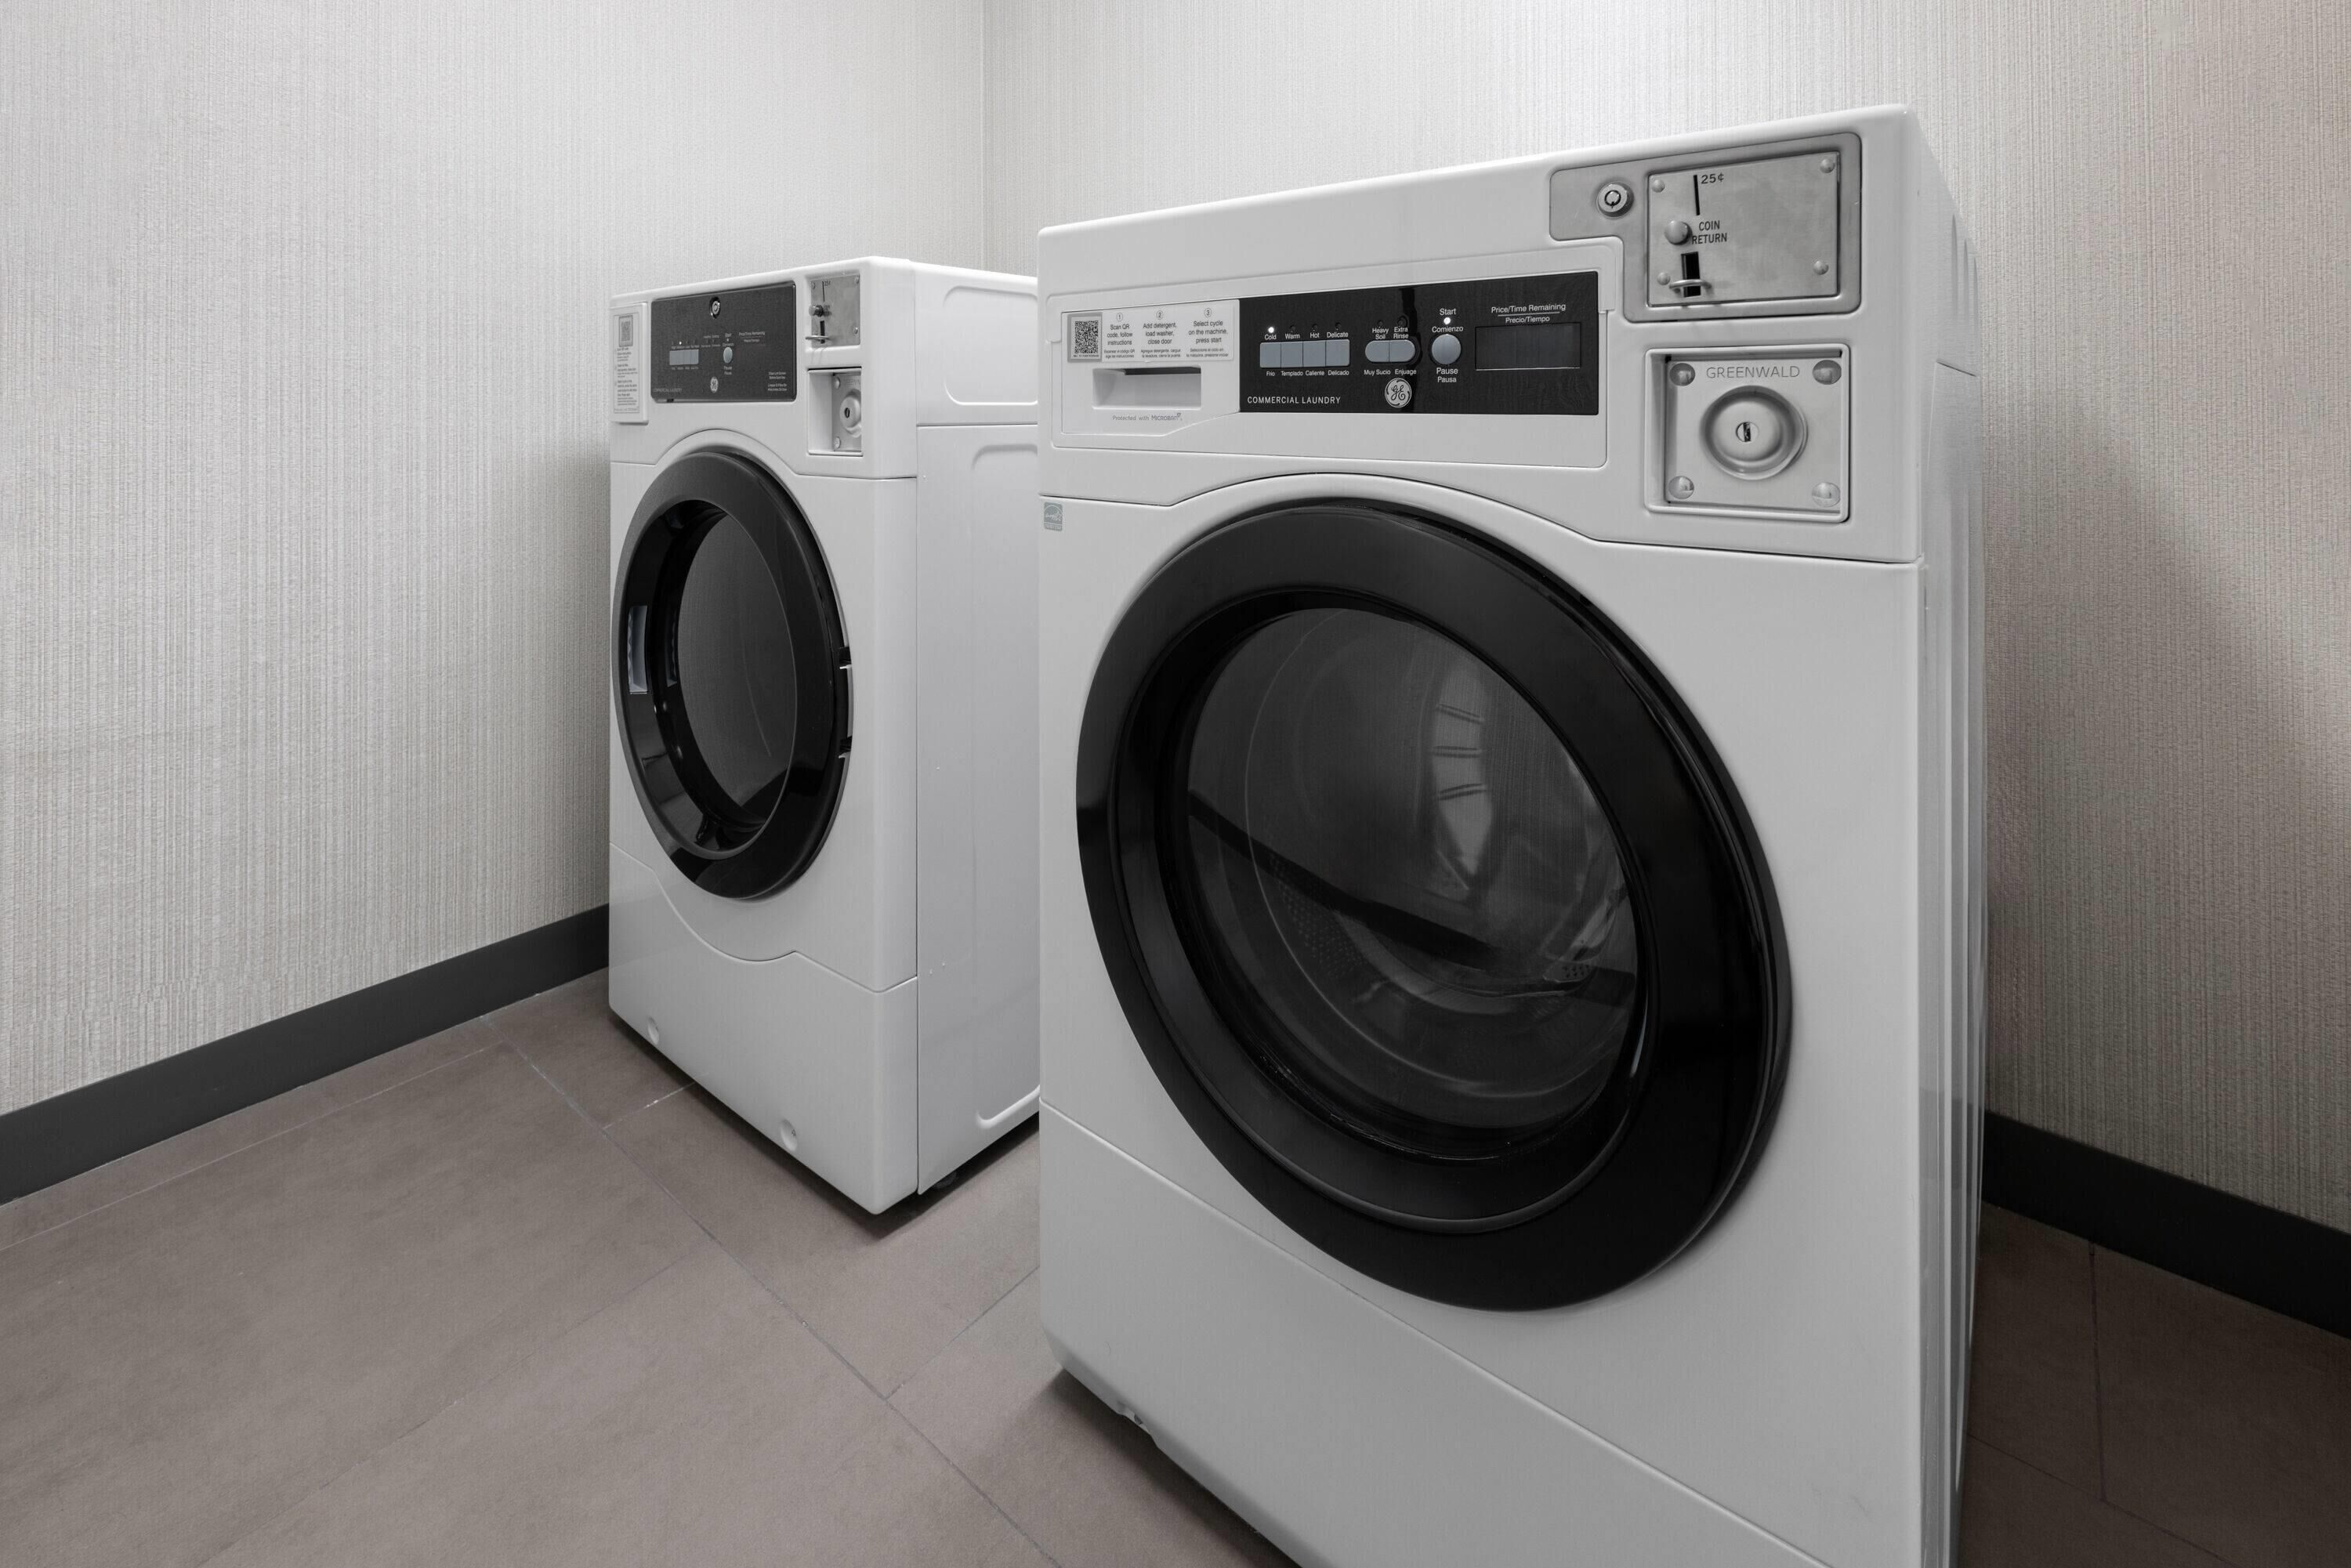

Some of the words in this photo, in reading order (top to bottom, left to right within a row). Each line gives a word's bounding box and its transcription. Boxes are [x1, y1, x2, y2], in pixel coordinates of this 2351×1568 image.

[1701, 172, 1725, 185] 25¢
[1698, 219, 1721, 231] COIN
[1691, 232, 1728, 245] RETURN
[1440, 307, 1456, 316] Start
[1491, 306, 1527, 314] Price/Time
[1528, 303, 1566, 312] Remaining
[1705, 365, 1801, 380] GREENWALD
[1247, 396, 1299, 404] COMMERCIAL
[1302, 396, 1341, 404] LAUNDRY
